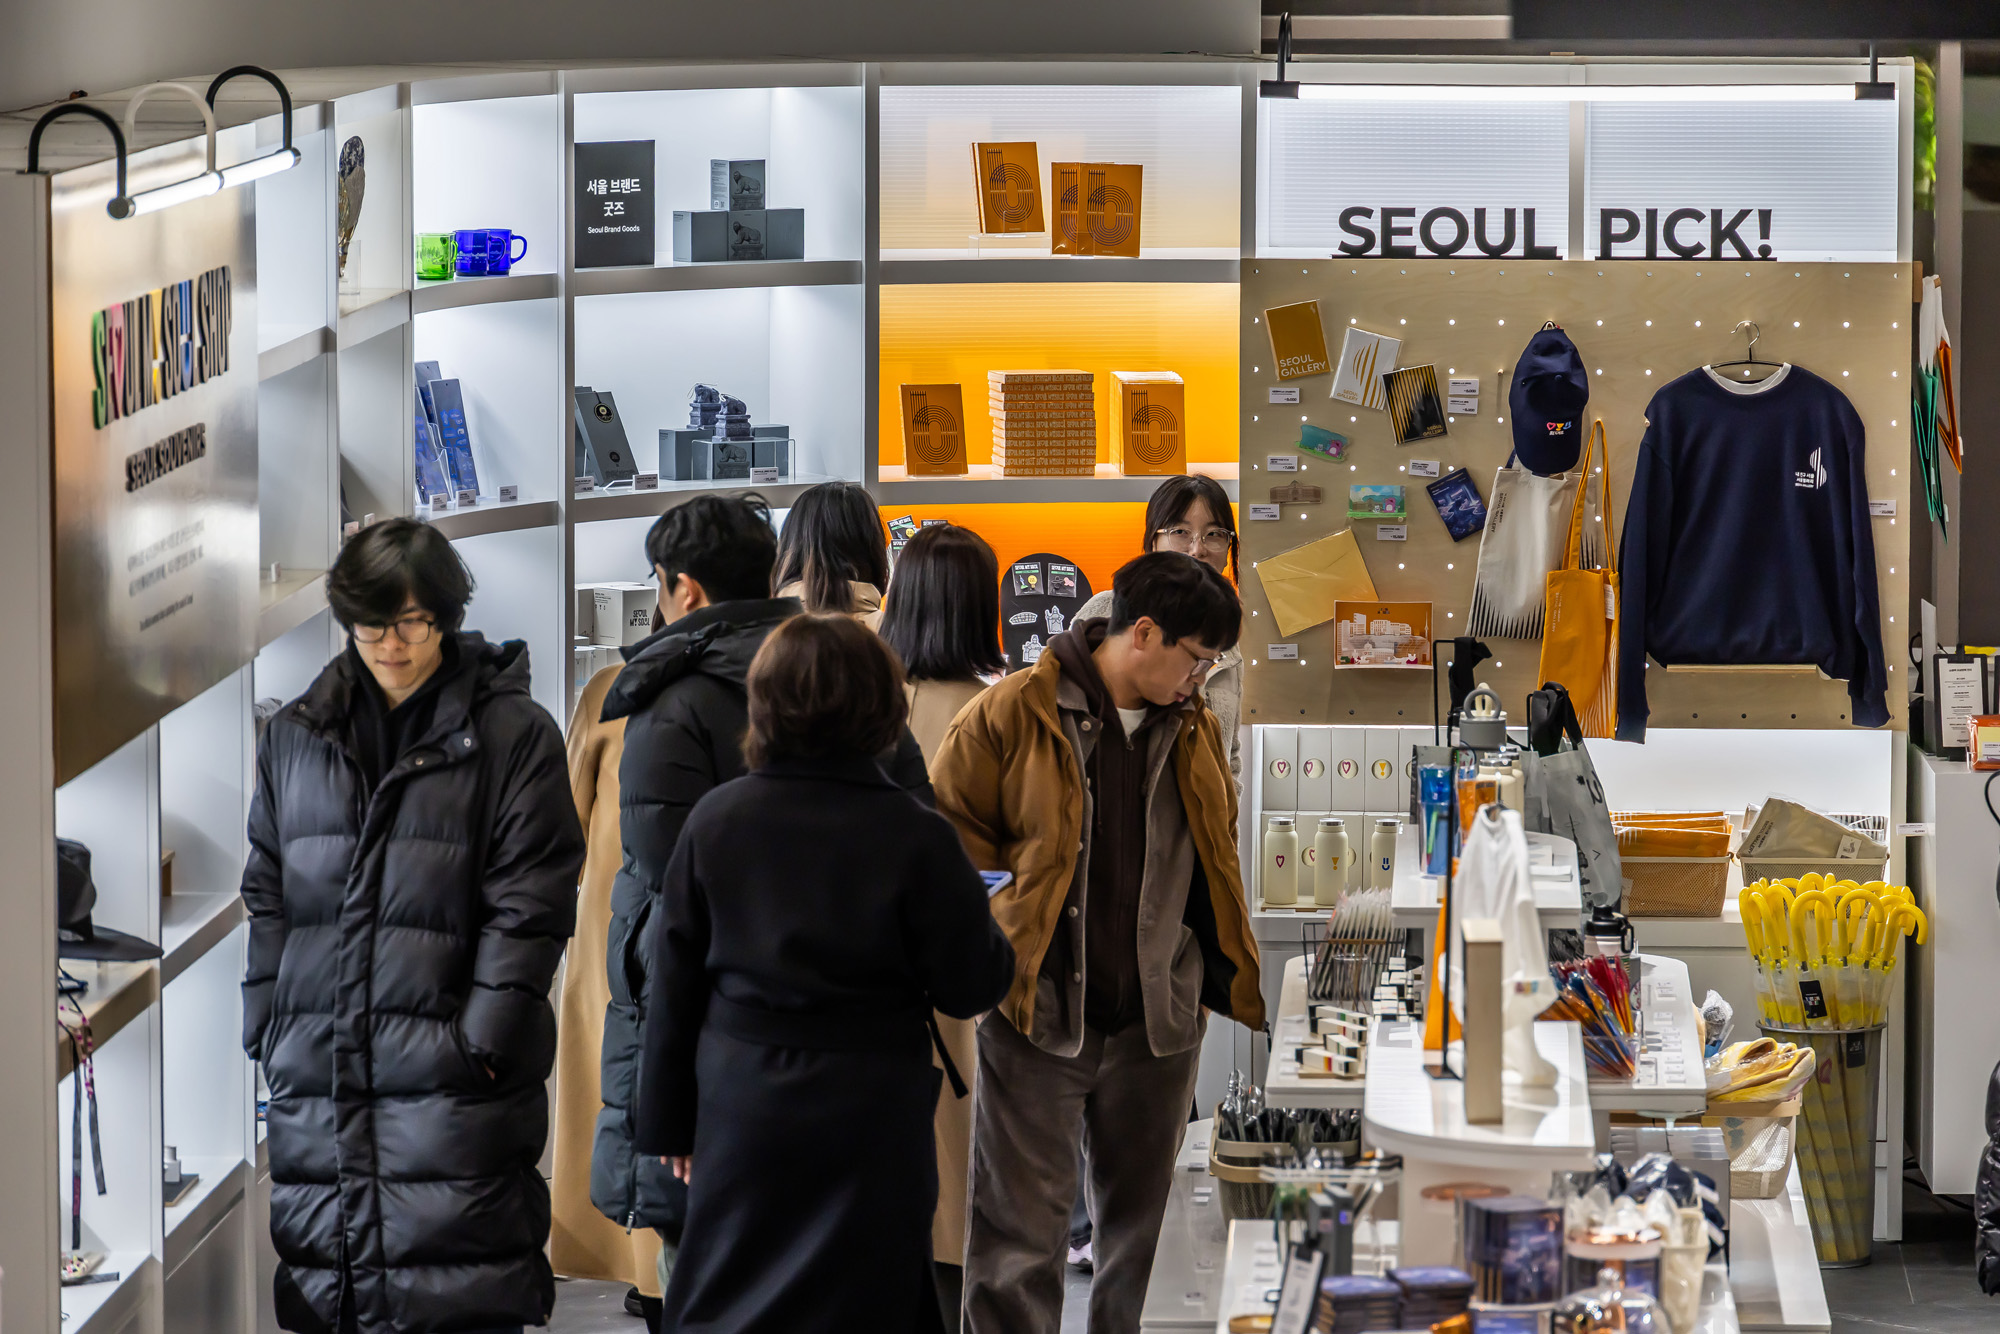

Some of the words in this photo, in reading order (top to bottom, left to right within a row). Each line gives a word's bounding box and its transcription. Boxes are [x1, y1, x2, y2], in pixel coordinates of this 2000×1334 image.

[587, 179, 608, 195] 서울
[610, 178, 641, 194] 브랜드
[603, 201, 625, 217] 굿즈
[587, 225, 603, 234] Seoul
[604, 225, 621, 233] Brand
[622, 224, 640, 233] Goods
[1338, 206, 1557, 257] SEOUL
[1600, 207, 1773, 259] PICK!
[198, 264, 232, 384] SHOP
[1279, 353, 1315, 368] SEOUL
[1280, 360, 1327, 377] GALLERY
[1336, 392, 1359, 402] GALLERY
[1343, 388, 1359, 397] SEOUL
[1422, 428, 1444, 437] GALLERY
[125, 446, 157, 492] SEOUL
[155, 422, 206, 478] SOUVENIRS
[633, 609, 647, 618] SEOUL
[638, 618, 650, 626] SOUL
